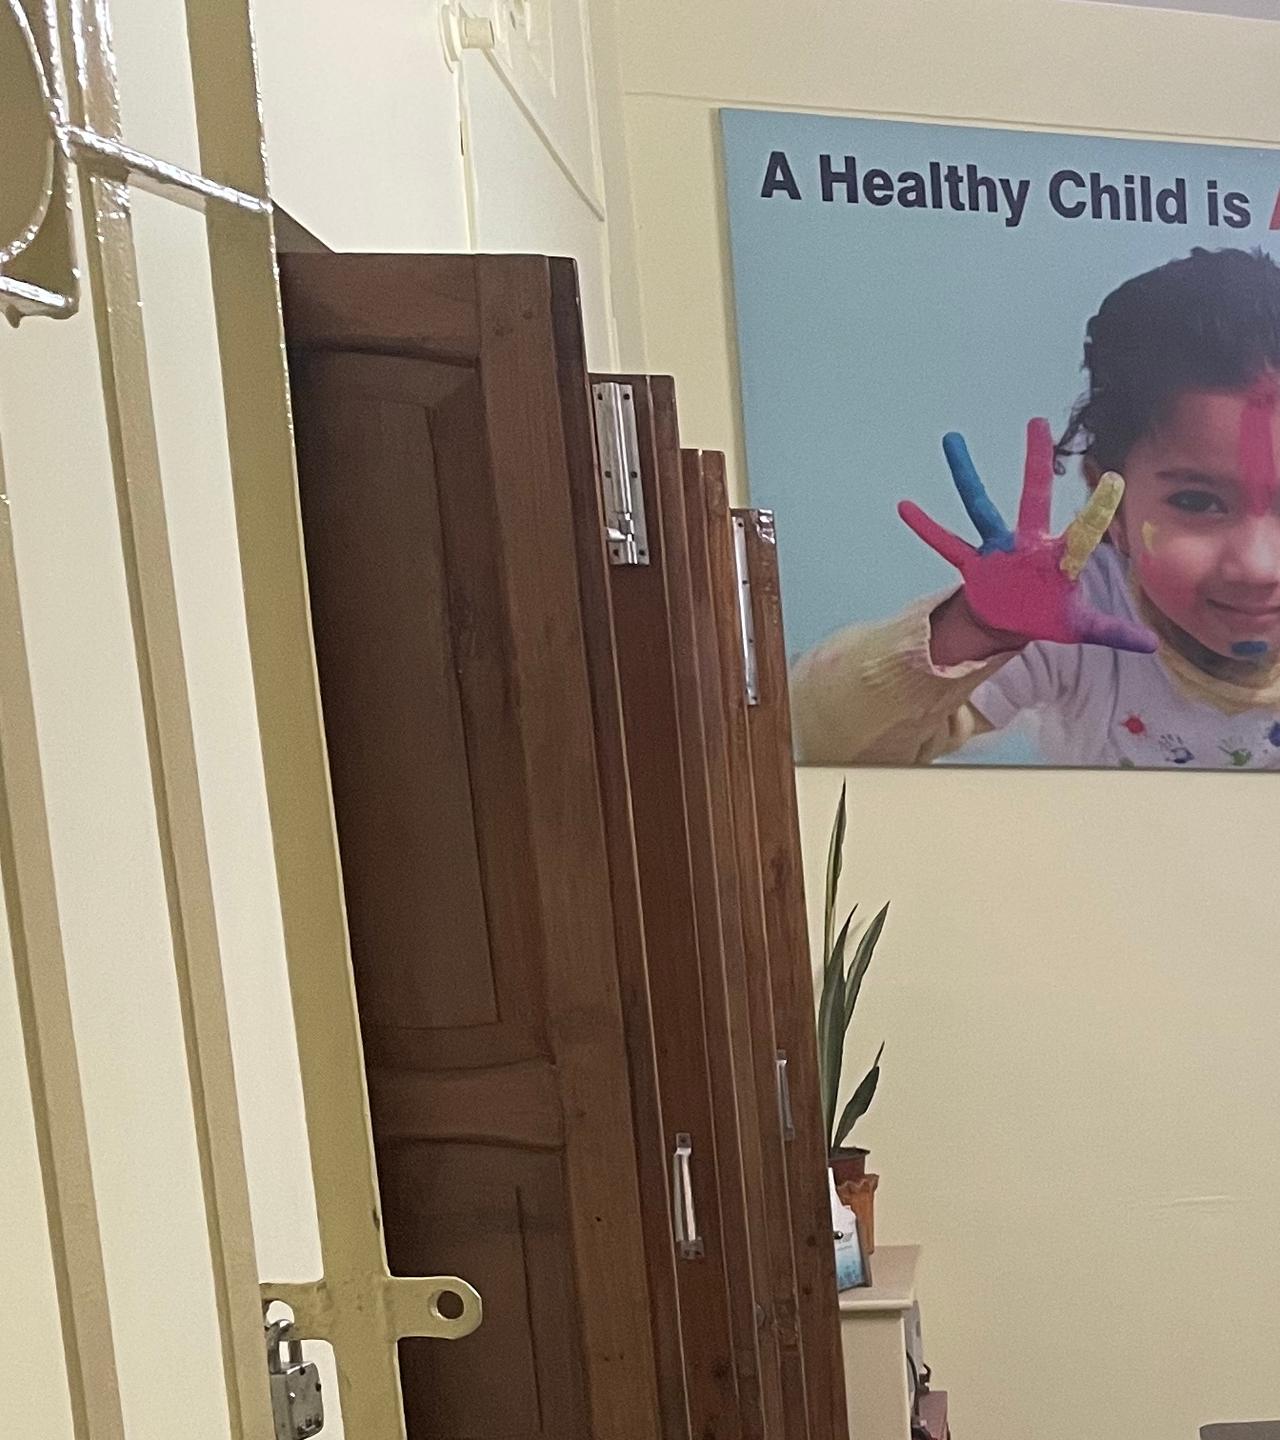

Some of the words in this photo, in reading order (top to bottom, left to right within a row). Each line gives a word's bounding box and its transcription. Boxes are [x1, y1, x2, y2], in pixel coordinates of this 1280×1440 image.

[760, 150, 802, 201] A
[819, 154, 1031, 228] Healthy
[1048, 169, 1188, 225] Child
[1206, 179, 1251, 229] is
